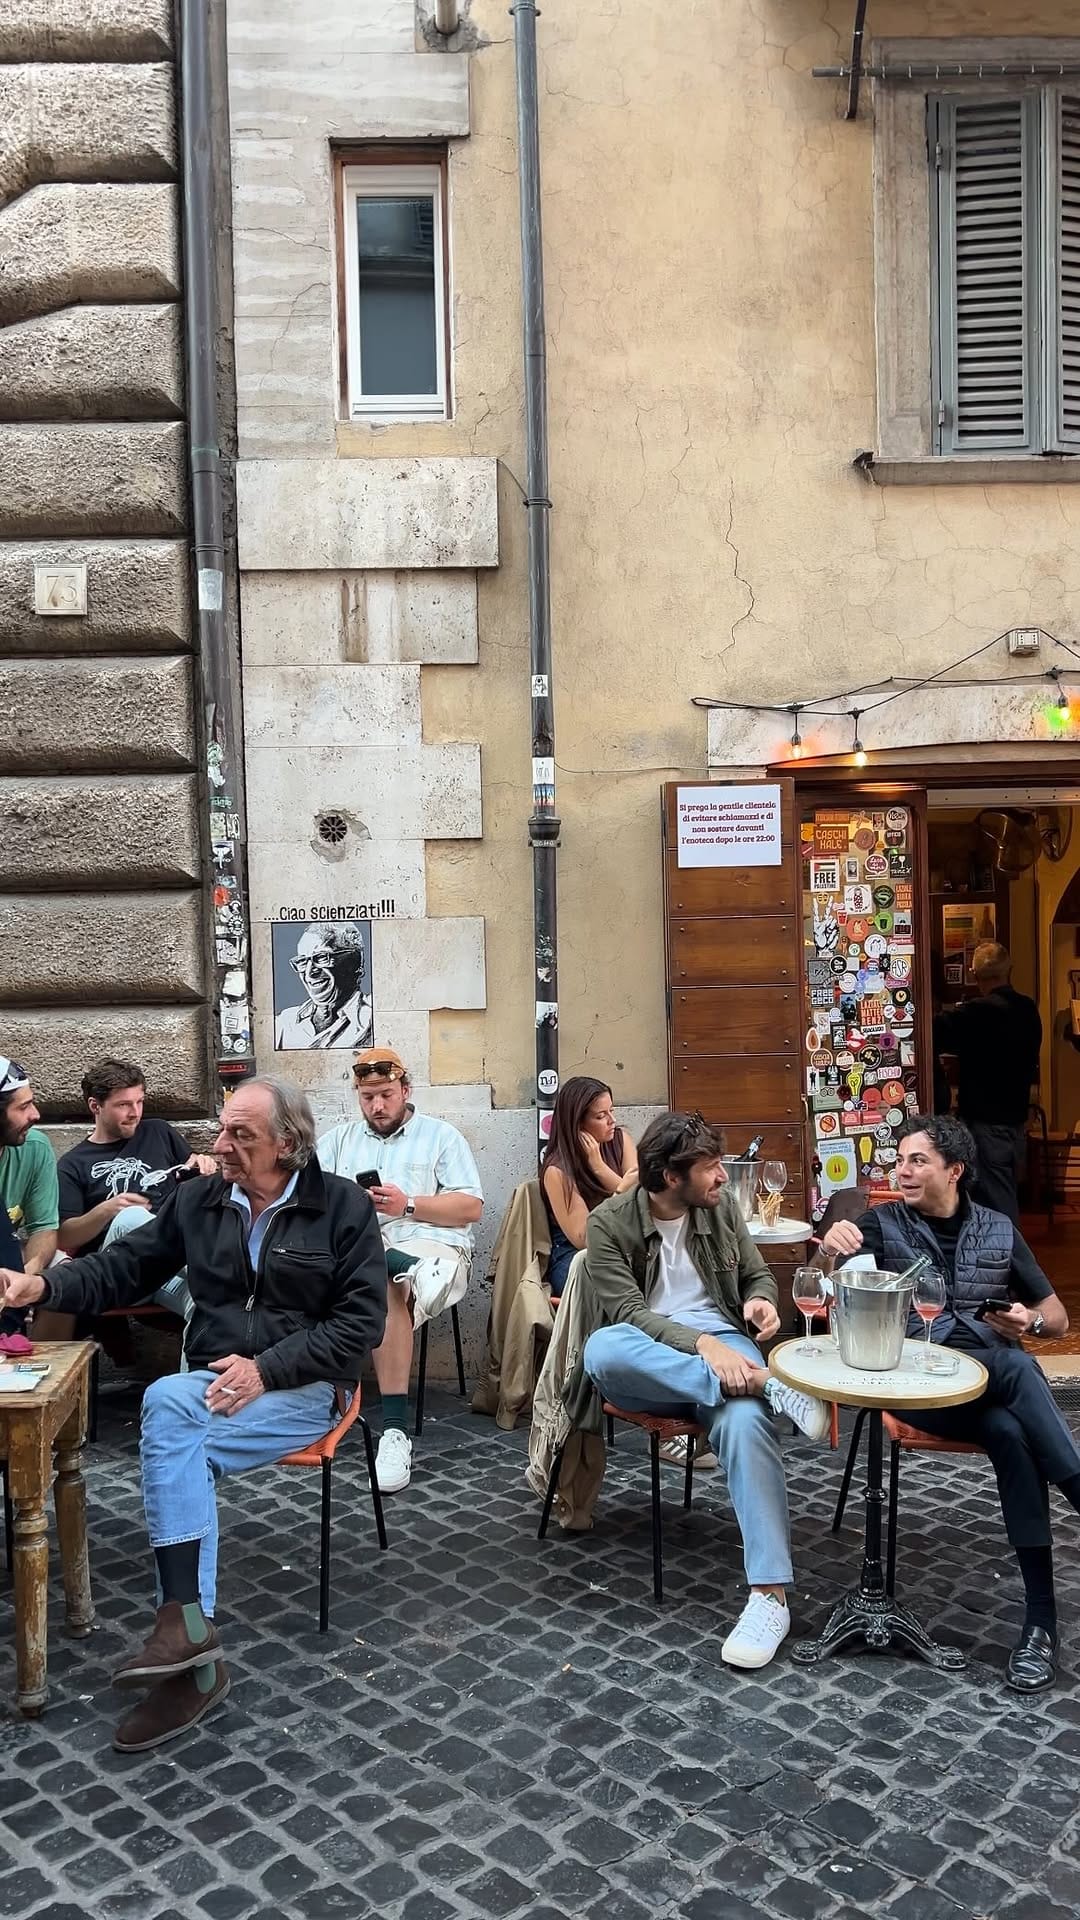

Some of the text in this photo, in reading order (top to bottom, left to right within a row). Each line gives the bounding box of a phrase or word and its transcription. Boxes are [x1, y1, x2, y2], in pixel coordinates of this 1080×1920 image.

[719, 802, 744, 811] gentile
[745, 801, 776, 809] clientela
[691, 814, 717, 822] evitare
[718, 812, 759, 821] schiamazzi
[715, 836, 733, 845] dopo
[756, 834, 775, 842] 22:00
[813, 872, 836, 883] FREE
